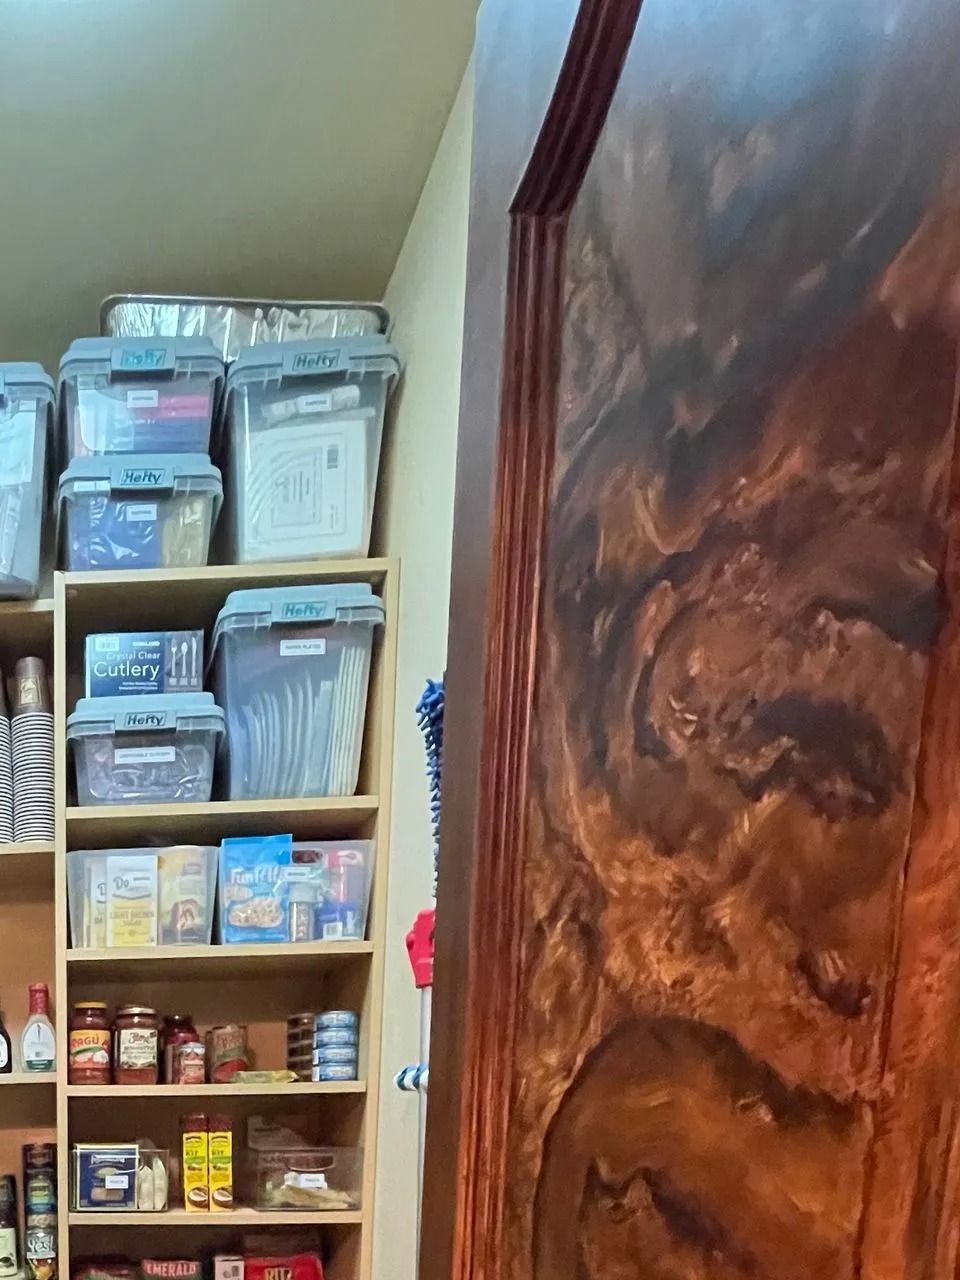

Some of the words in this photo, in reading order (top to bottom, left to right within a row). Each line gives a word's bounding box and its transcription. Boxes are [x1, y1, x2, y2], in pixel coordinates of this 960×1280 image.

[295, 353, 337, 368] Hefty
[124, 470, 162, 485] Hefty
[285, 603, 323, 617] Hefty
[106, 651, 136, 664] Crystal
[137, 650, 161, 661] Clear
[93, 660, 161, 681] Cutlery
[127, 714, 165, 727] Hefty
[27, 1235, 54, 1253] Yes!
[146, 1262, 197, 1277] EMERALD
